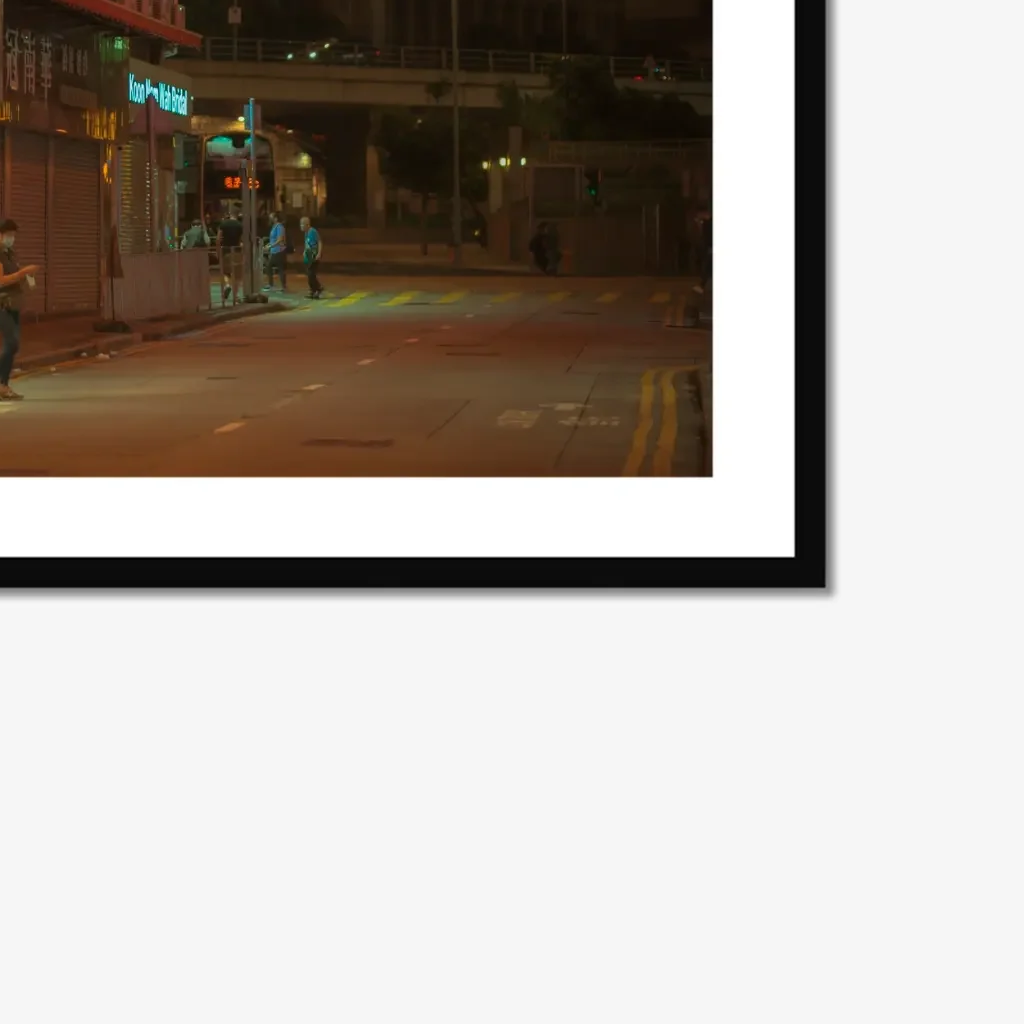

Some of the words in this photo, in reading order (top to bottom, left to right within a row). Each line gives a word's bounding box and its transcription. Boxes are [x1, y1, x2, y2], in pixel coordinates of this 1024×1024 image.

[129, 72, 145, 104] Koon
[159, 82, 171, 111] Wah
[171, 86, 188, 116] Bridal
